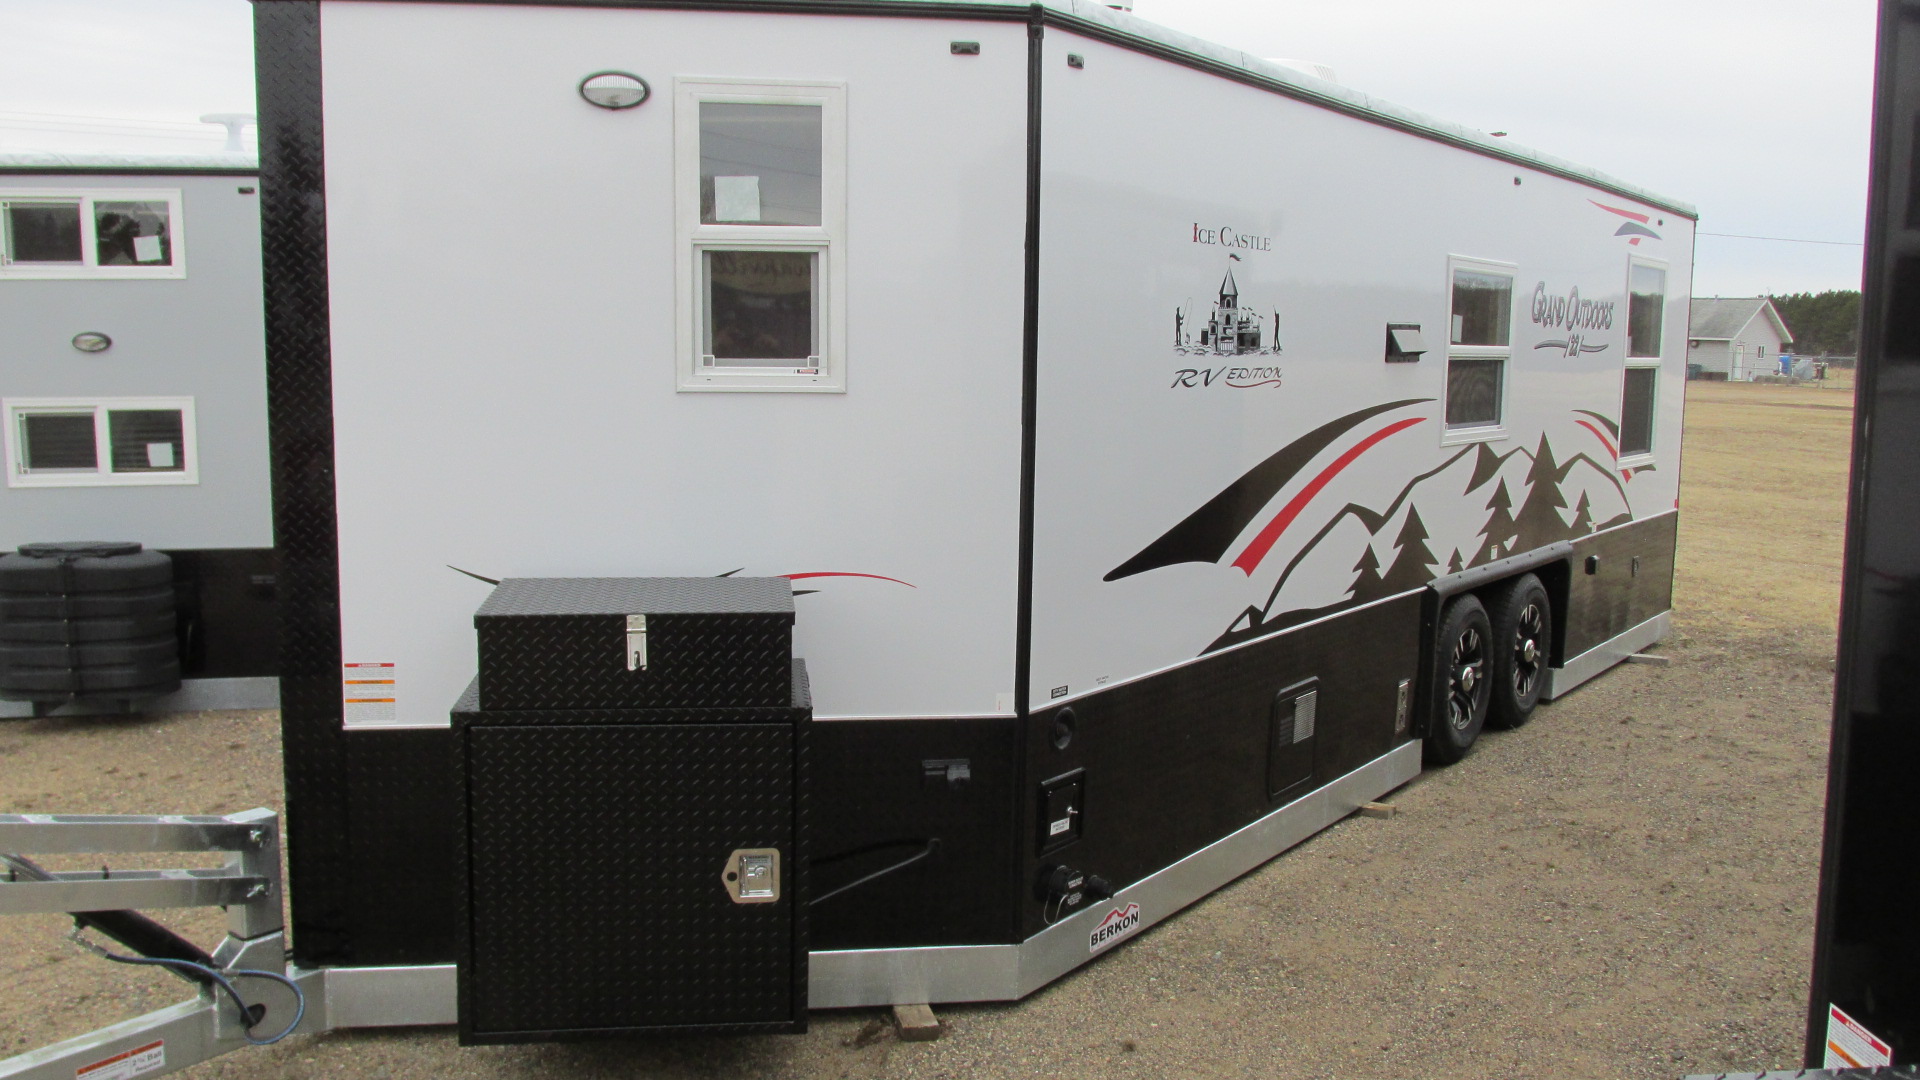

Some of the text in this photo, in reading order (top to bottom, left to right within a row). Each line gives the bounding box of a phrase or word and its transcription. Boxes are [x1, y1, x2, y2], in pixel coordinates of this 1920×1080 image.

[1193, 222, 1271, 251] ICE CASTLE
[1531, 280, 1614, 332] GRAND OUTDOORS
[1170, 365, 1283, 389] RV EDITION
[1091, 911, 1139, 947] BERKON
